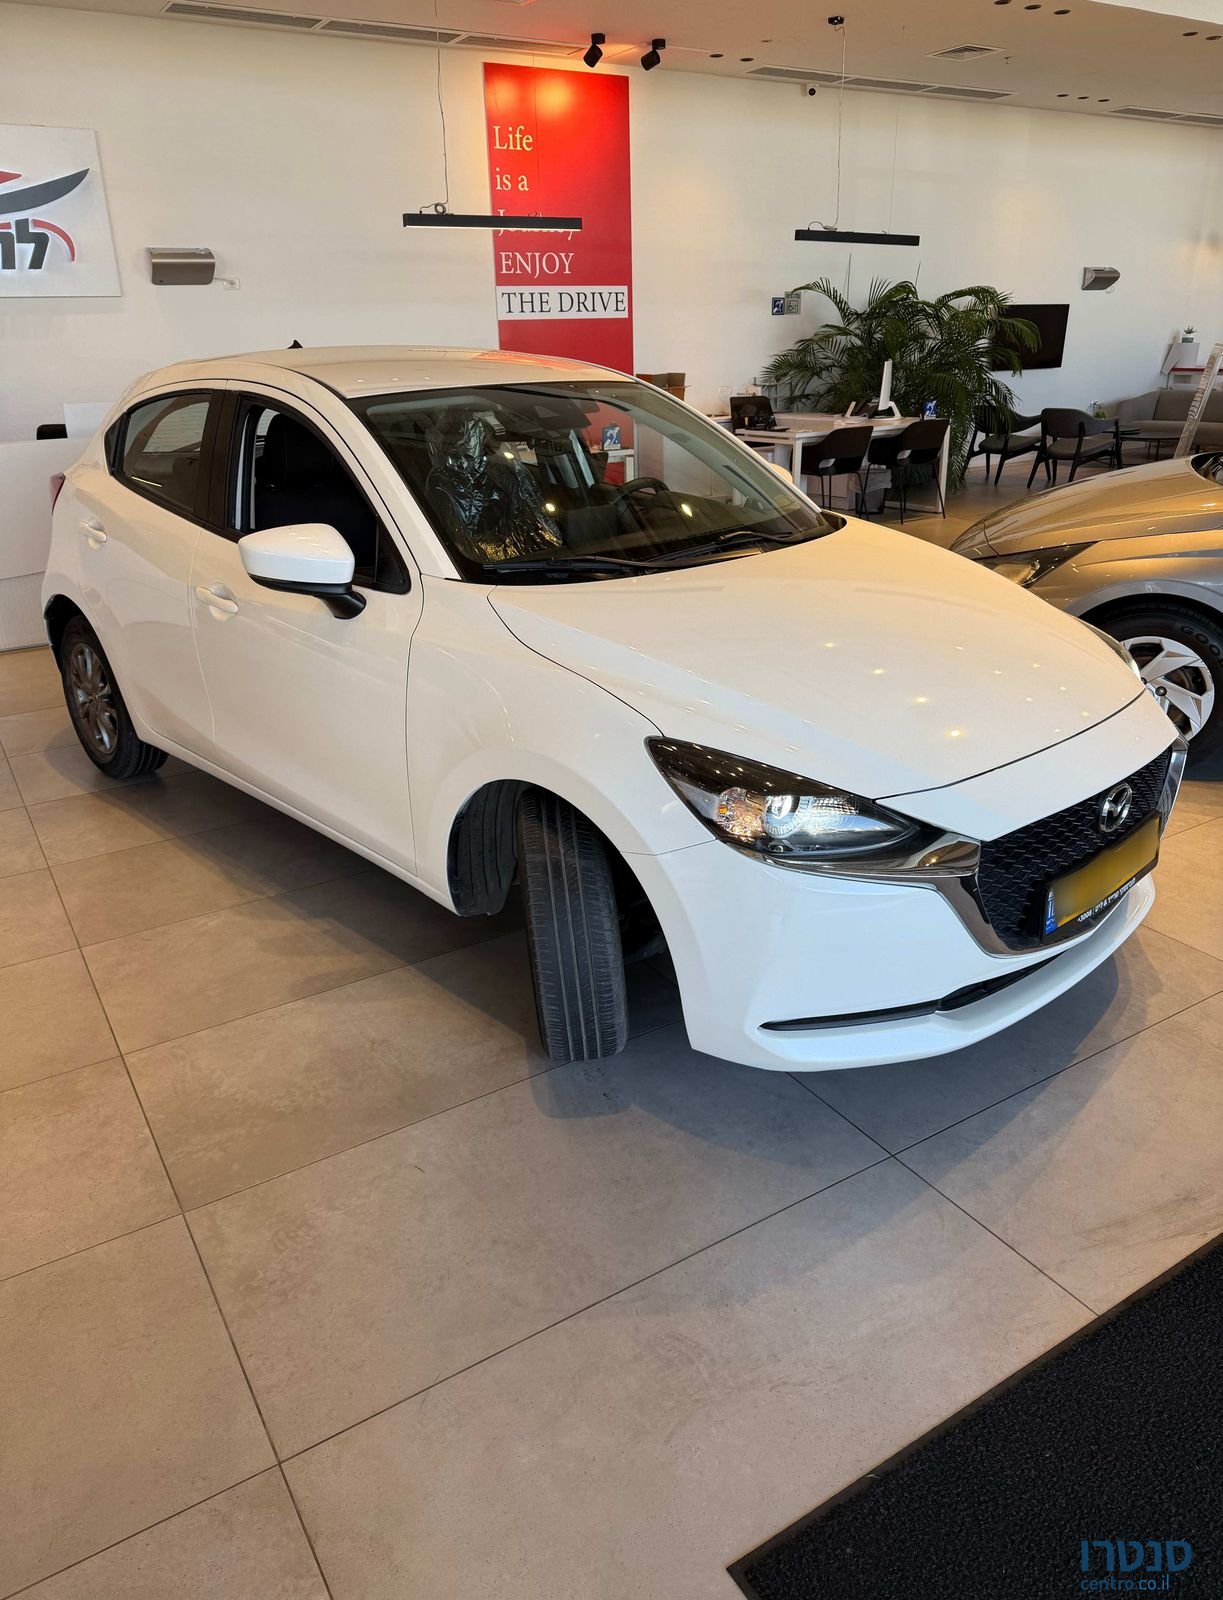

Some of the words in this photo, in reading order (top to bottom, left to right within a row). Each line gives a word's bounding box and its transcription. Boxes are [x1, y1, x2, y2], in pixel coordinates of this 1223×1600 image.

[492, 125, 533, 151] Life
[495, 167, 512, 191] is
[518, 175, 529, 191] a
[500, 251, 575, 278] ENJOY
[502, 292, 551, 313] THE
[558, 291, 626, 312] DRIVE
